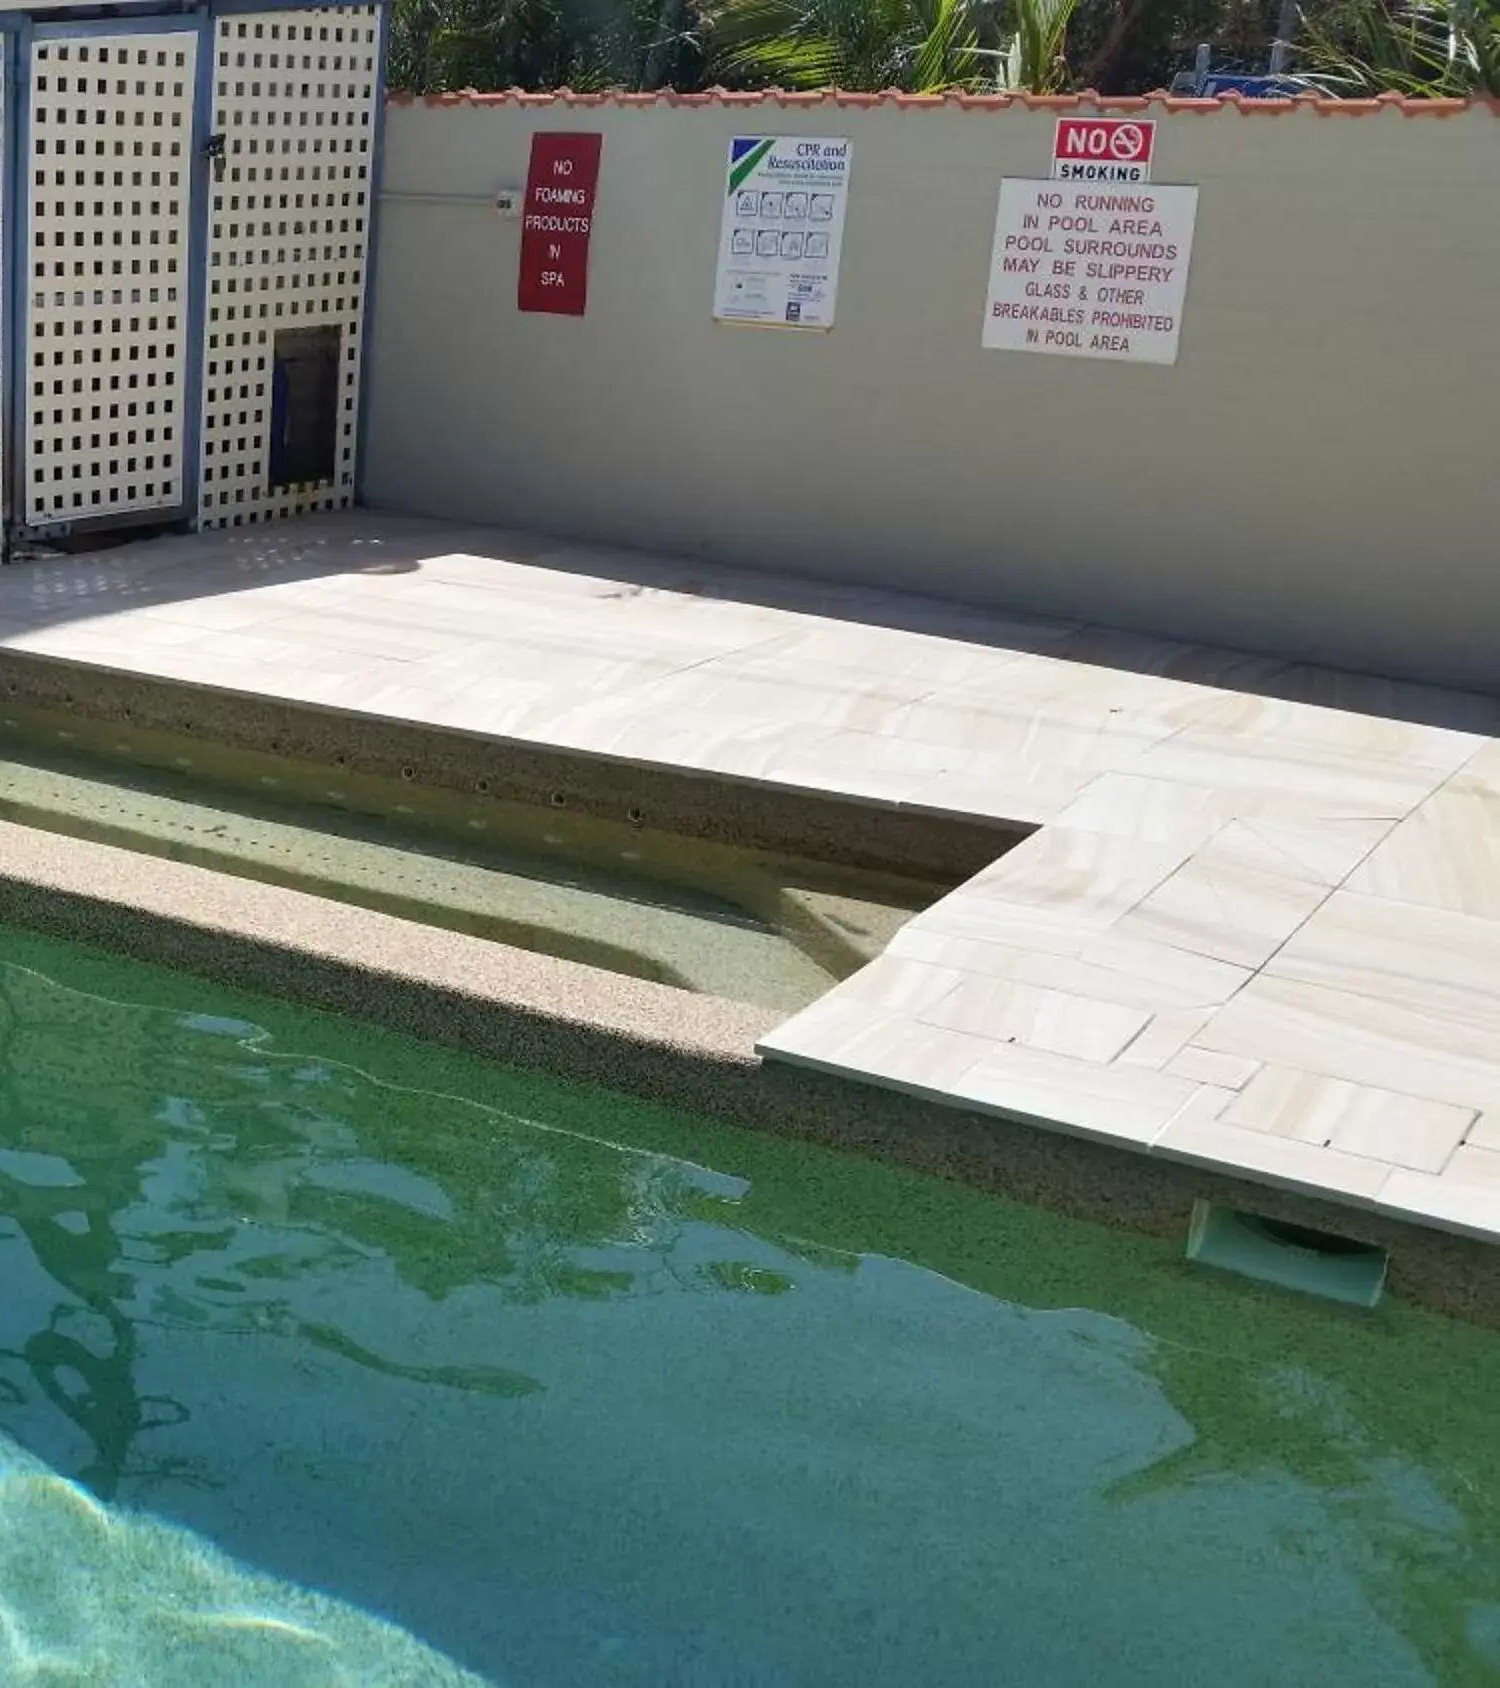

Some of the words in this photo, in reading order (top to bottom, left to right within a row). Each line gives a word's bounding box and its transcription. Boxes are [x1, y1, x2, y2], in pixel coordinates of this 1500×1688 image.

[797, 143, 820, 157] CPR
[823, 143, 847, 157] and
[1066, 127, 1107, 155] NO
[553, 159, 573, 176] NO
[767, 155, 845, 171] Resuscitation
[1060, 164, 1141, 181] SMOKING
[535, 187, 585, 205] FOAMING
[1037, 193, 1063, 209] NO
[1075, 195, 1155, 213] RUNNING
[525, 215, 589, 233] PRODUCTS
[1023, 215, 1039, 230] IN
[1048, 216, 1099, 234] POOL
[1109, 219, 1163, 237] AREA
[548, 244, 561, 260] IN
[1005, 235, 1053, 252] POOL
[1063, 239, 1177, 261] SURROUNDS
[540, 271, 565, 287] SPA
[1003, 258, 1040, 273] MAY
[1052, 260, 1076, 277] BE
[1086, 262, 1174, 283] SLIPPERY
[1025, 281, 1070, 300] GLASS
[1078, 286, 1088, 300] &
[1097, 287, 1145, 305] OTHER
[992, 303, 1085, 325] BREAKABLES
[1092, 310, 1174, 332] PROHIBITED
[1026, 329, 1039, 344] IN
[1045, 330, 1082, 348] POOL
[1089, 335, 1130, 352] AREA
